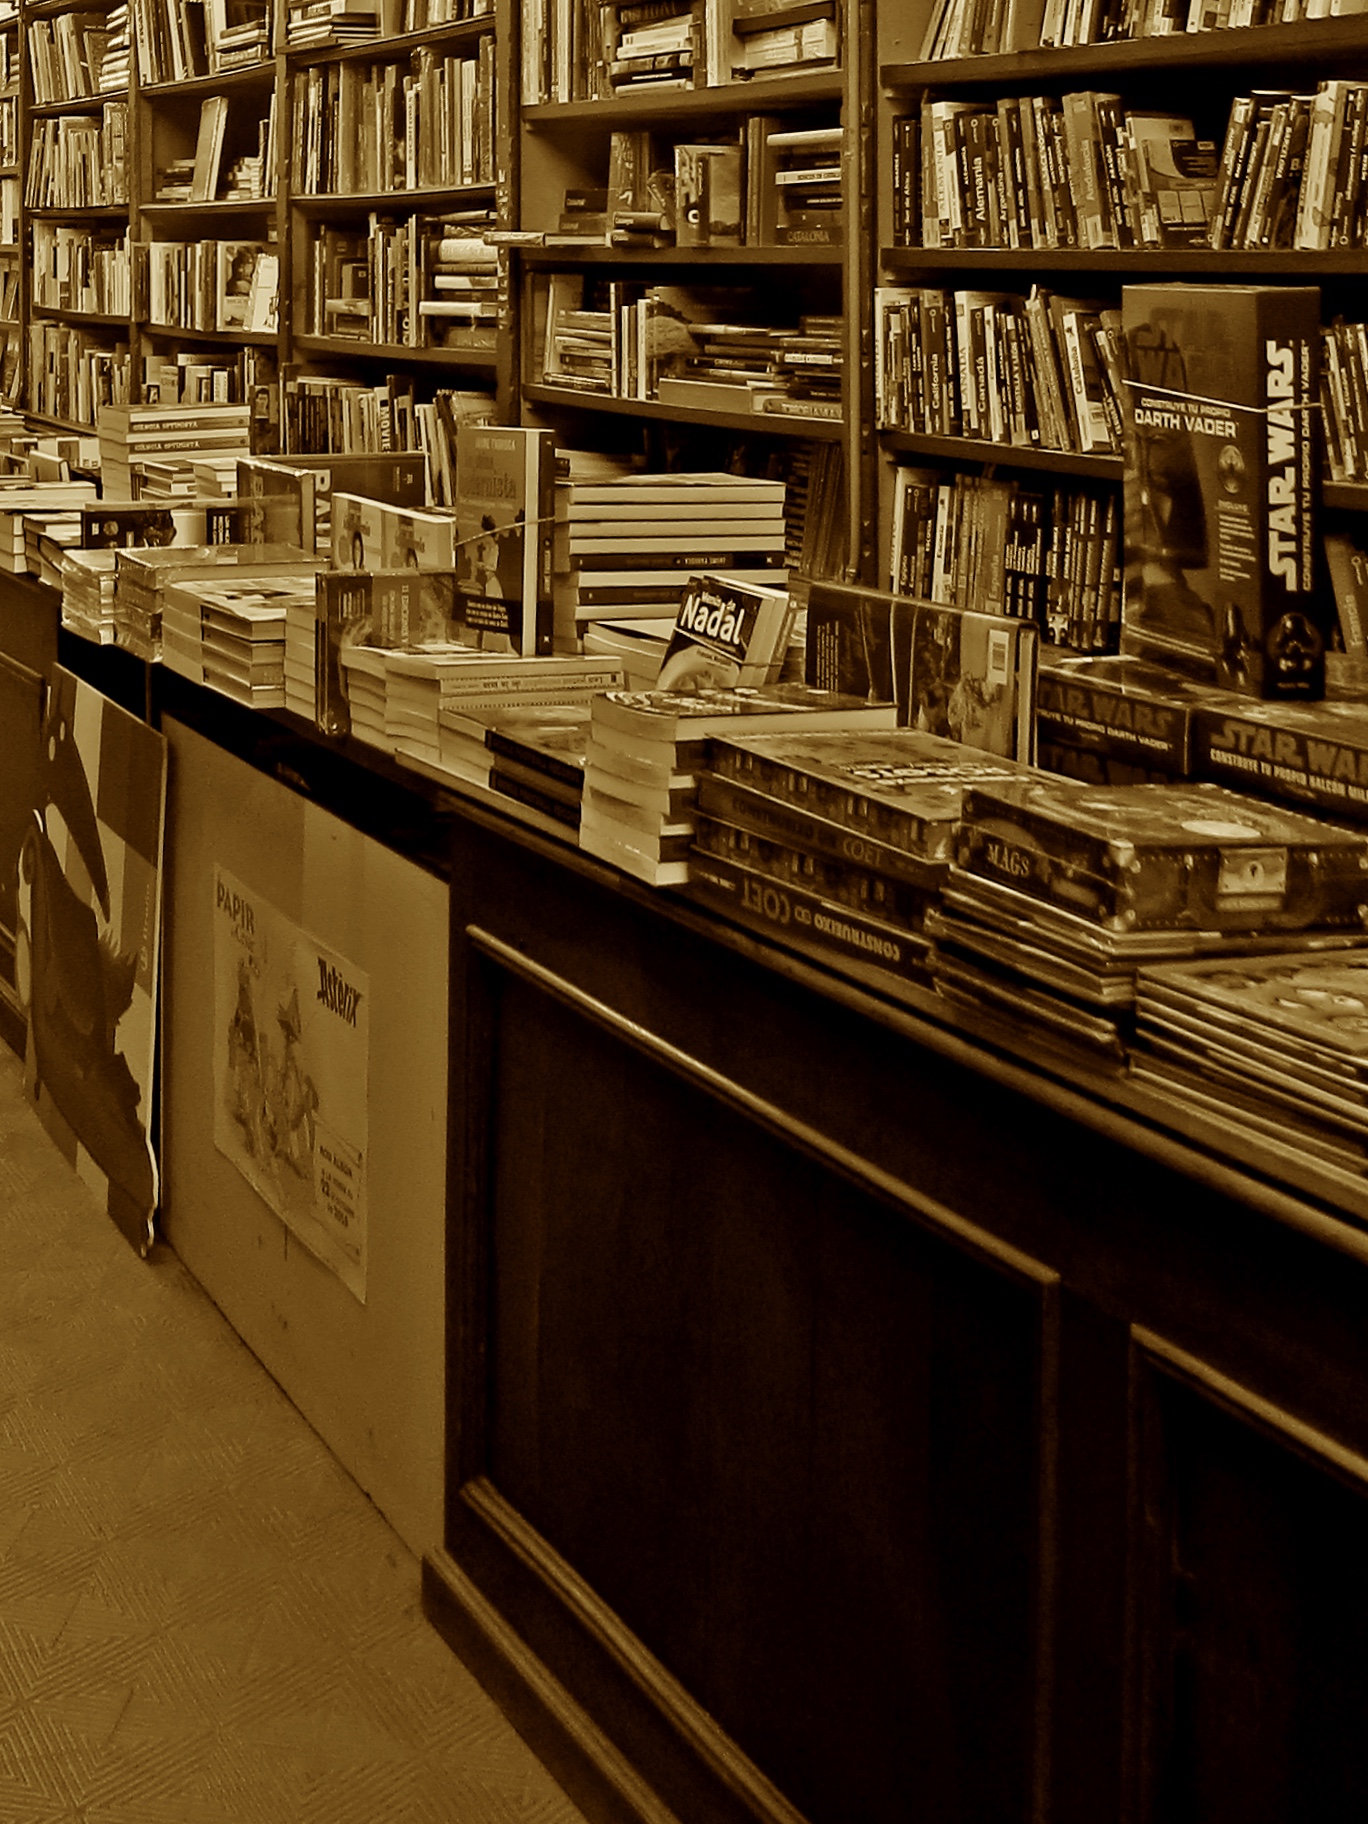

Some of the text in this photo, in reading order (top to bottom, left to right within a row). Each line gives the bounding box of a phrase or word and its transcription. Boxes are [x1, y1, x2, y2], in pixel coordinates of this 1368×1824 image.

[971, 156, 986, 221] Alemania
[931, 352, 941, 410] California
[976, 355, 986, 413] Canadá
[1140, 396, 1186, 414] CONSTRUYE
[1187, 402, 1200, 414] TU
[381, 405, 392, 454] MOVIE
[1134, 408, 1238, 439] DARTH VADER
[1265, 339, 1299, 592] STAR WARS
[1299, 344, 1313, 592] CONSTRUYE TU PROPIO DARTH VADER
[679, 593, 745, 646] Nadal
[1210, 720, 1302, 766] STAR
[216, 883, 256, 936] PAPIR
[740, 876, 792, 925] COET
